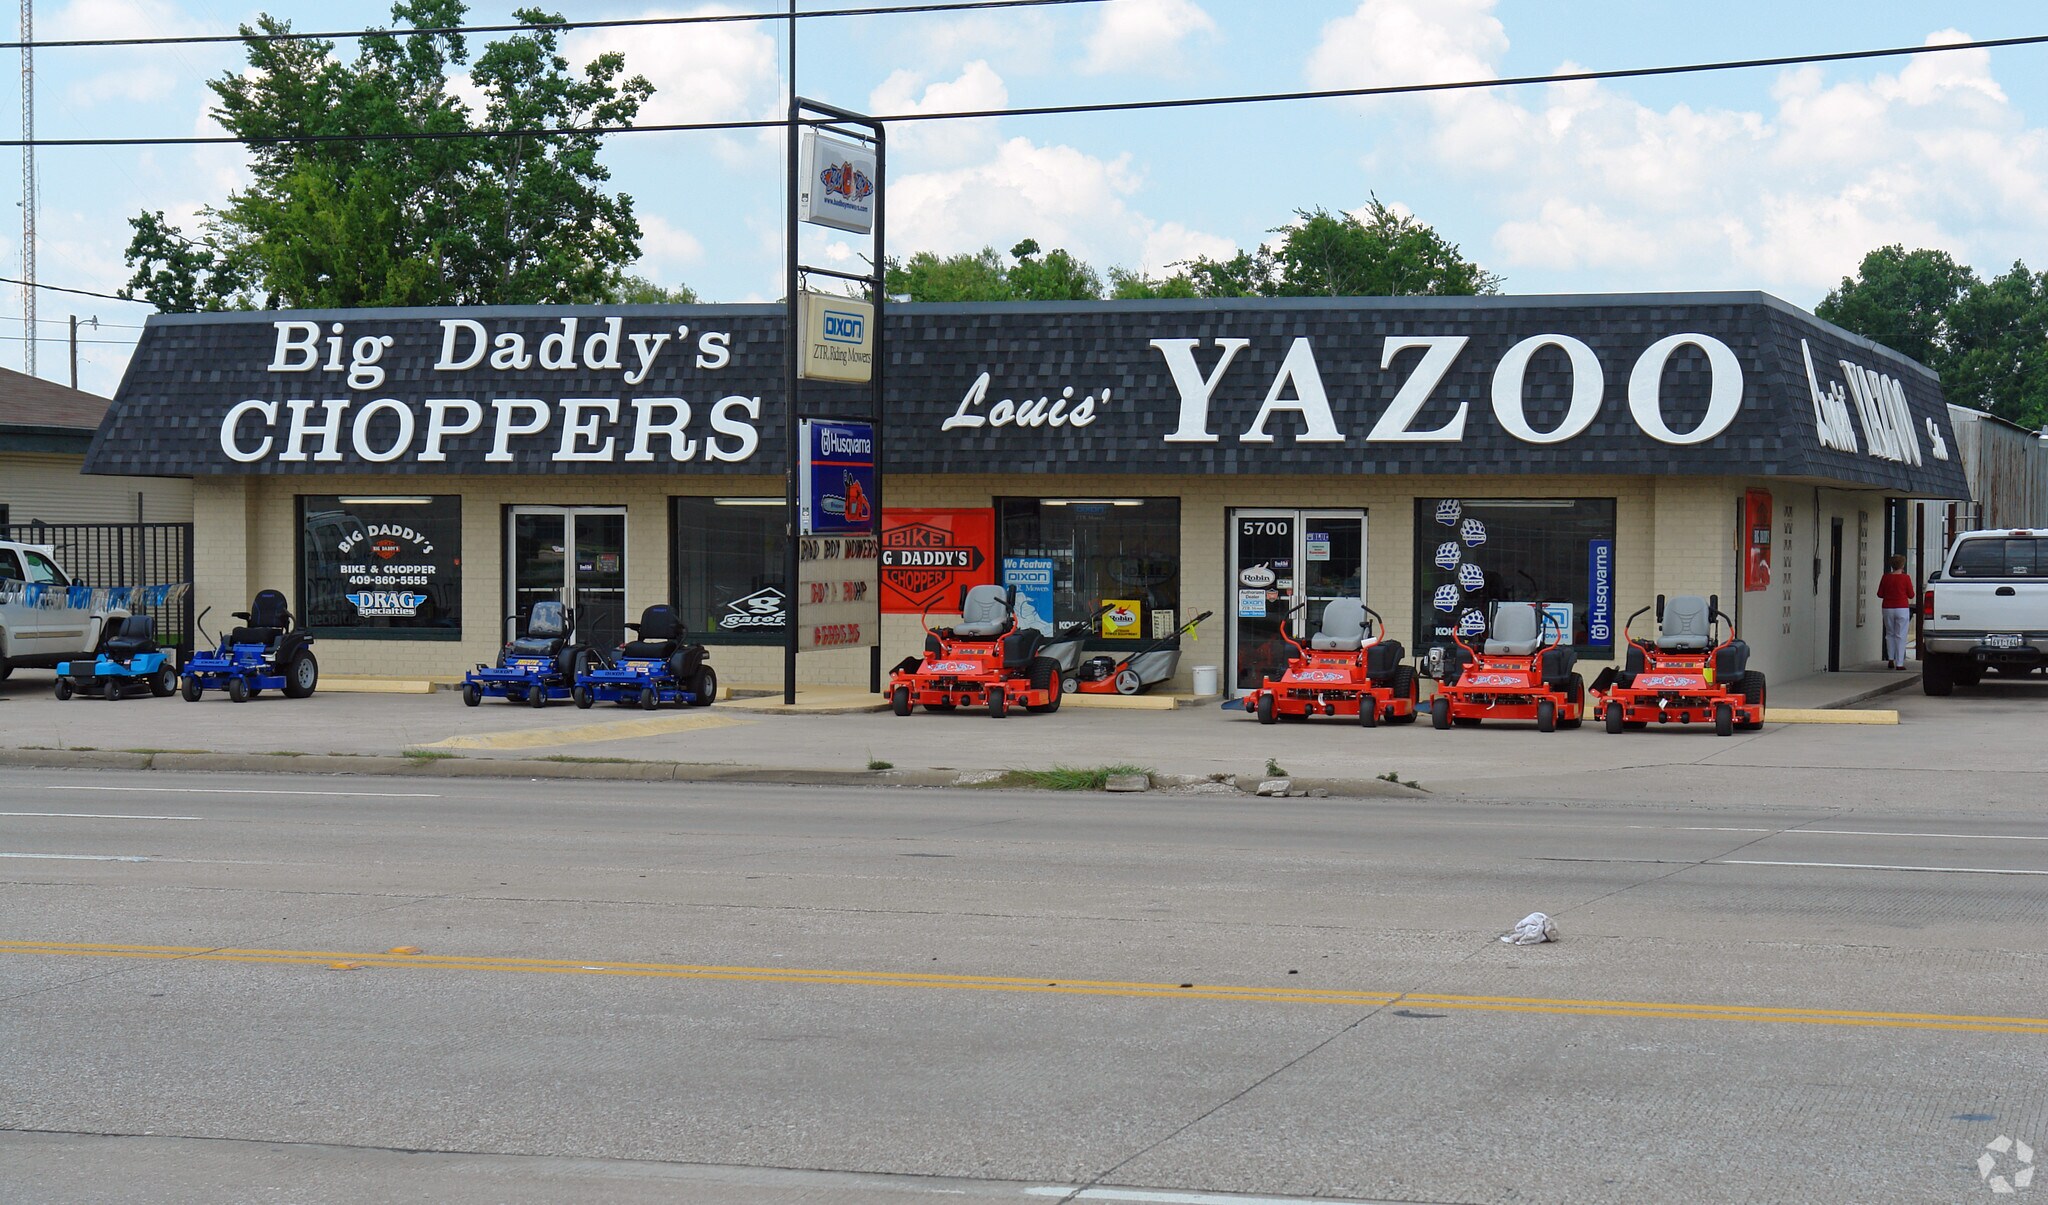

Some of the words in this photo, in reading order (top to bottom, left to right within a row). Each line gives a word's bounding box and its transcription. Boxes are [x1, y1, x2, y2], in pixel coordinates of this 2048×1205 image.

[825, 316, 862, 338] DIXON
[268, 322, 394, 390] Big
[434, 317, 731, 385] Daddy's
[830, 346, 848, 366] Riding
[847, 347, 872, 364] Mowers
[941, 371, 1111, 431] Louis'
[1149, 333, 1745, 444] YAZOO
[1839, 359, 1922, 467] YAZOO
[221, 396, 761, 462] CHOPPERS
[831, 433, 871, 456] Husqvarna
[891, 528, 943, 546] BIKE
[1243, 522, 1288, 535] 5700
[338, 530, 364, 554] BIG
[367, 523, 434, 554] DADDY'S
[823, 540, 840, 559] BOY
[844, 539, 878, 559] MOWERS
[901, 550, 968, 566] DADDY'S
[340, 565, 366, 574] BIKE
[370, 565, 379, 574] &
[383, 565, 436, 574] CHOPPER
[1004, 559, 1017, 569] We
[1019, 559, 1052, 569] Feature
[349, 576, 428, 585] 409-860-5555
[890, 570, 943, 591] CHOPPER
[1008, 573, 1047, 581] DIXON
[1243, 574, 1271, 582] Robin
[1593, 546, 1609, 623] Husqvarna
[1025, 584, 1049, 592] Mowers
[359, 592, 415, 608] DRAG
[359, 607, 415, 617] Specialties
[1436, 627, 1467, 636] KOHLE
